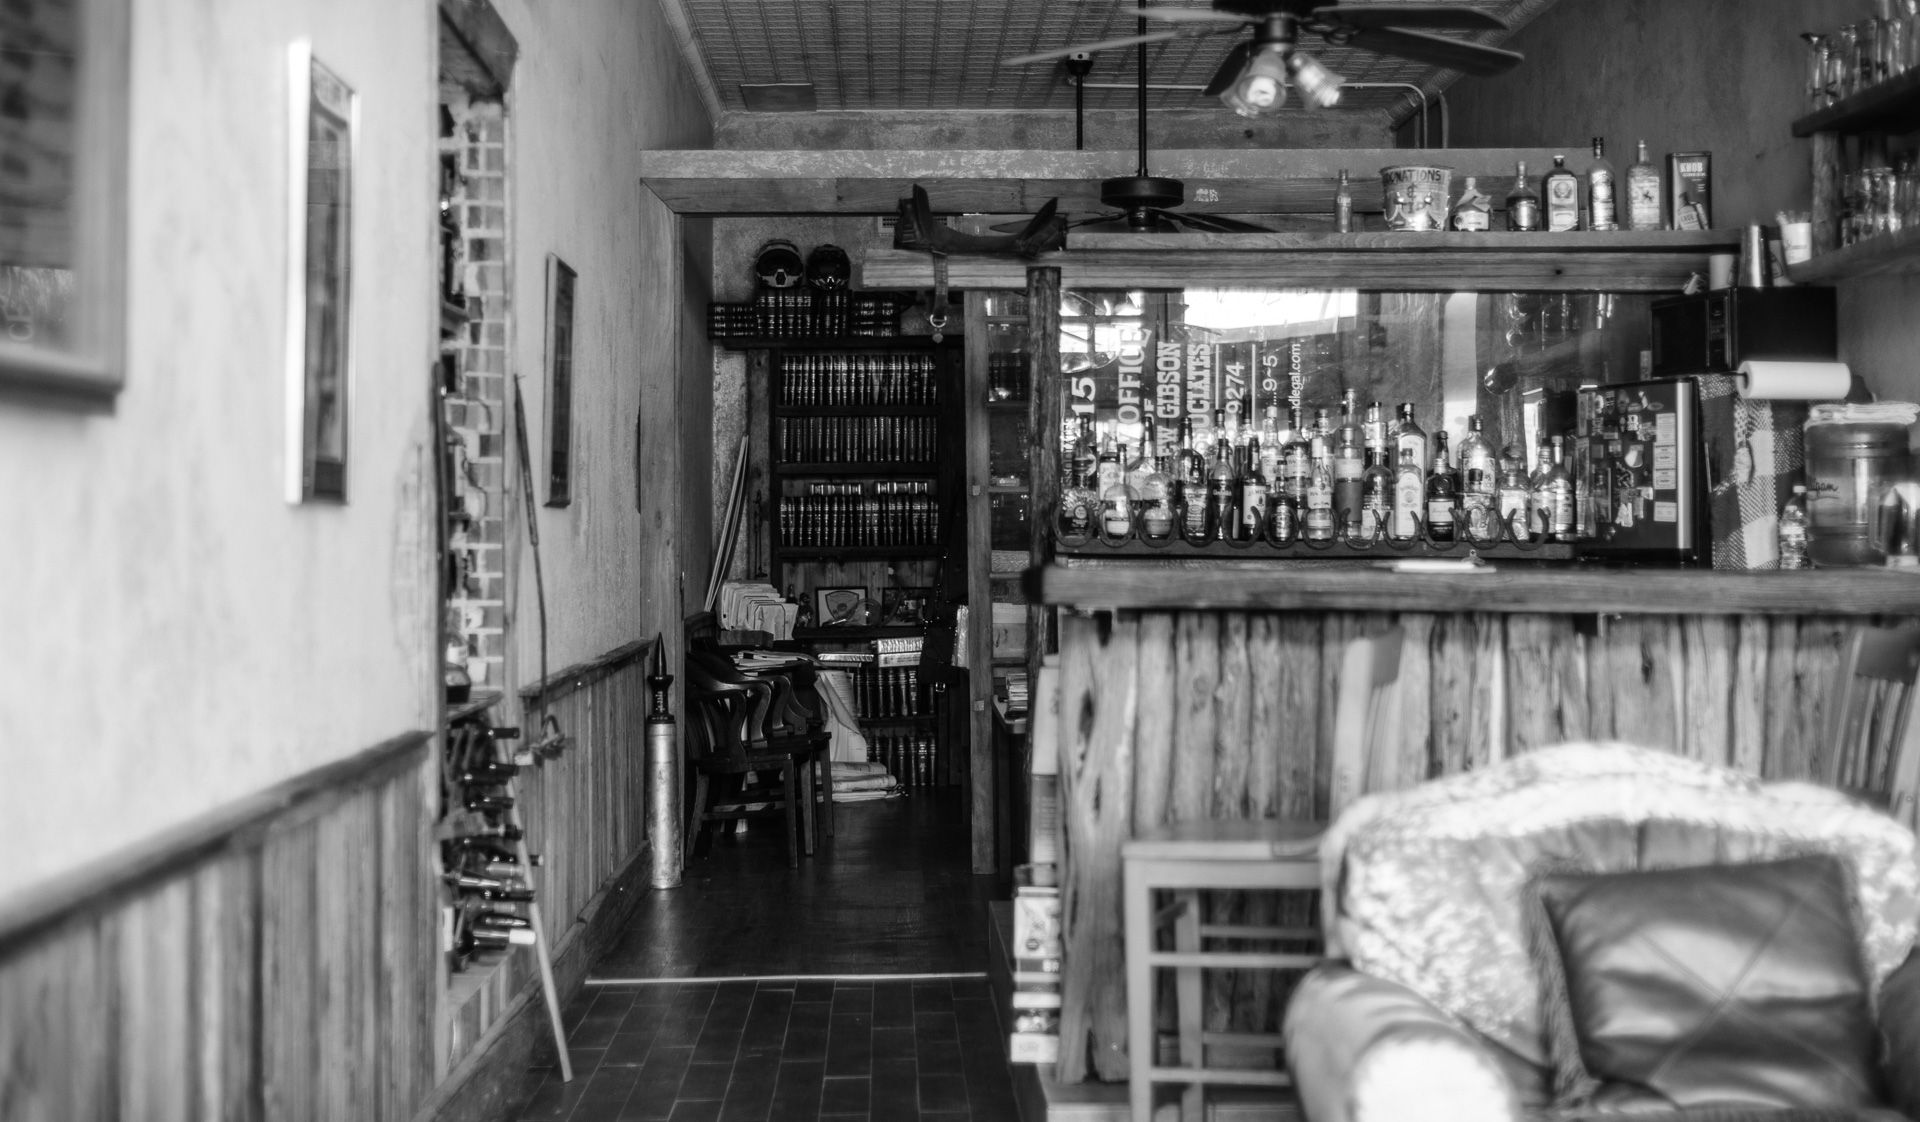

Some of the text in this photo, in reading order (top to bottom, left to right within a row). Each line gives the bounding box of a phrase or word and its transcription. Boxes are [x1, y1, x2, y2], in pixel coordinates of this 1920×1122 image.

[1679, 161, 1703, 173] KNOB
[1117, 327, 1152, 424] OFFICE
[1156, 341, 1181, 419] GIBSON
[1225, 361, 1245, 414] 9274
